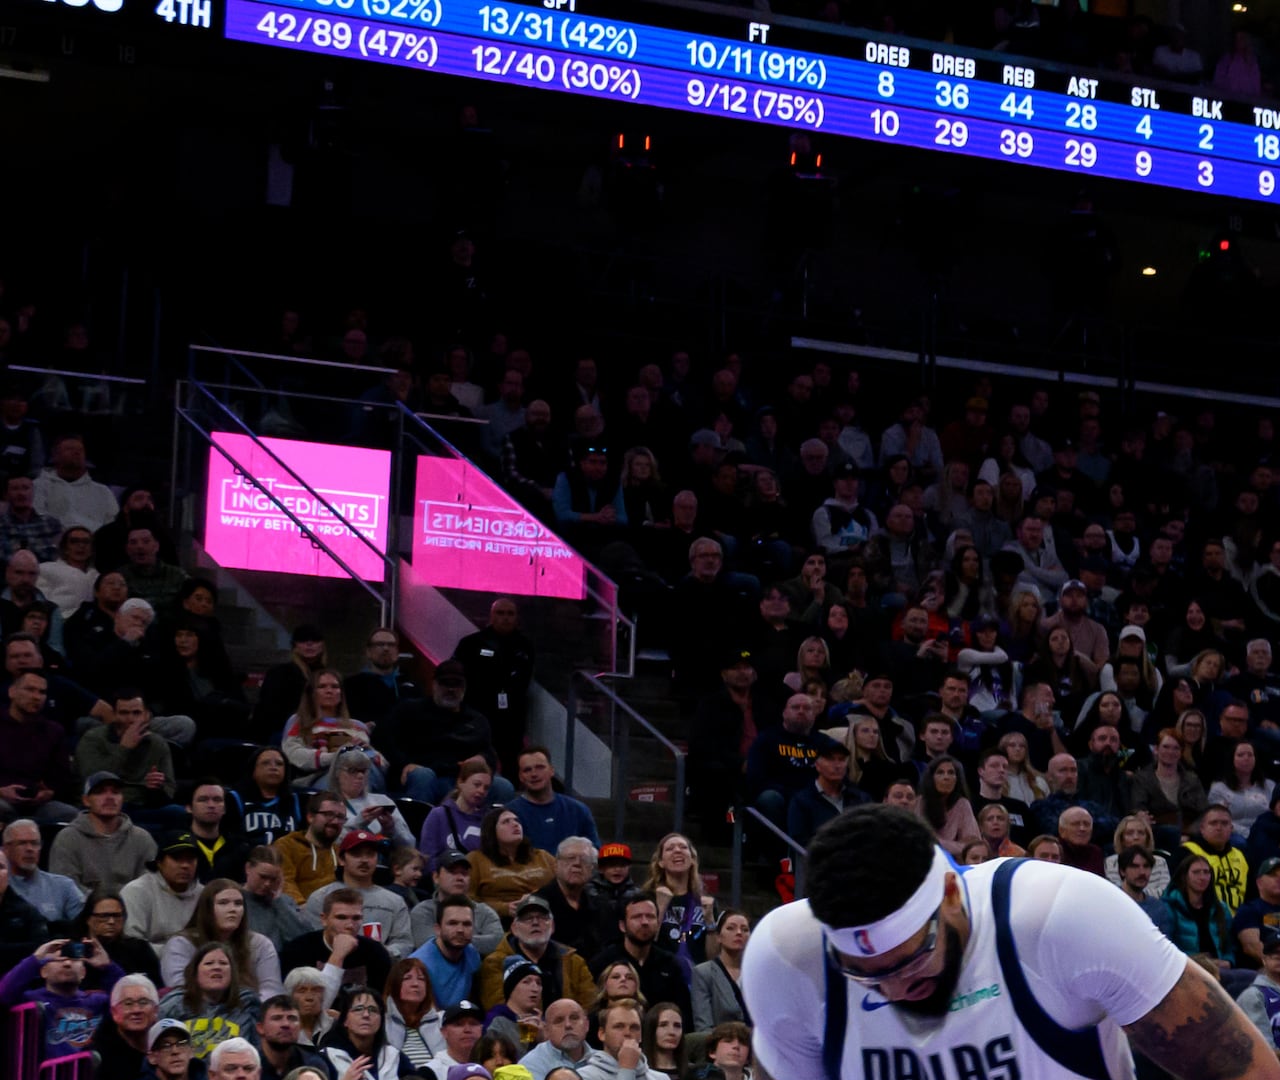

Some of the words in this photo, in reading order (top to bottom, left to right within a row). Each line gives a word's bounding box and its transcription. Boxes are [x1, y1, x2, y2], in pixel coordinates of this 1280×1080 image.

[157, 0, 211, 28] 4TH
[256, 10, 353, 50] 42/89
[358, 25, 439, 68] (47%)
[478, 5, 553, 42] 13/31
[560, 18, 638, 59] (42%)
[748, 22, 770, 44] FT
[686, 39, 752, 75] 10/11
[758, 50, 827, 90] (91%)
[865, 41, 910, 68] OREB
[932, 52, 976, 79] DREB
[471, 44, 556, 83] 12/40
[561, 58, 642, 100] (30%)
[877, 70, 895, 98] 8
[1002, 64, 1035, 89] REB
[935, 80, 969, 110] 36
[1067, 76, 1099, 99] AST
[1131, 86, 1161, 110] STL
[686, 78, 748, 114] 9/12
[753, 88, 825, 129] (75%)
[1000, 92, 1035, 120] 44
[1065, 101, 1098, 131] 28
[1192, 96, 1223, 121] BLK
[870, 108, 900, 137] 10
[934, 118, 969, 148] 29
[1135, 114, 1153, 140] 4
[1198, 123, 1214, 150] 2
[999, 128, 1034, 158] 39
[1064, 139, 1098, 168] 29
[1254, 133, 1280, 161] 18
[1135, 150, 1153, 177] 9
[1197, 160, 1214, 187] 3
[1258, 170, 1276, 196] 9
[220, 514, 262, 529] WHEY
